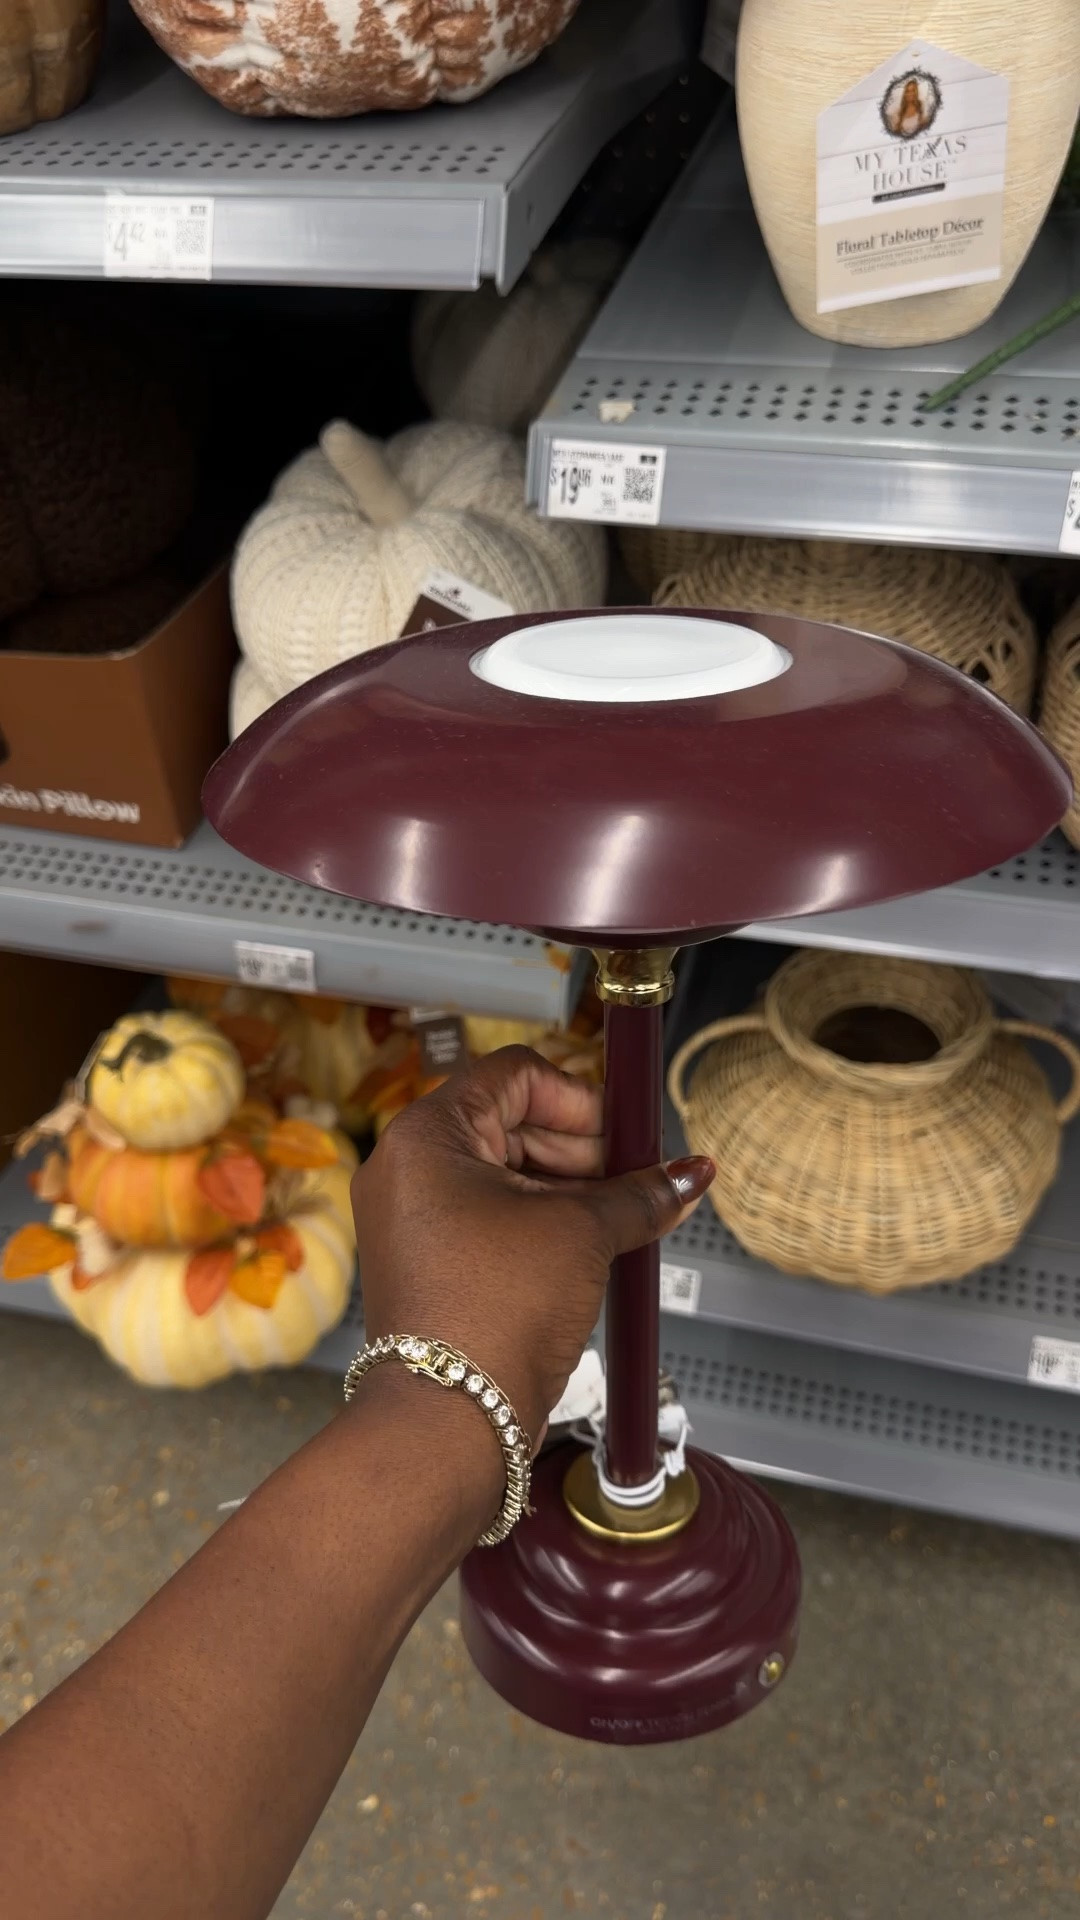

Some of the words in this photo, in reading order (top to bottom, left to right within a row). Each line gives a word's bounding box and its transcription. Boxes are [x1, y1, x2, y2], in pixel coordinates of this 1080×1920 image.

[855, 152, 883, 173] MY
[894, 134, 969, 166] TEXAS
[872, 160, 948, 191] HOUSE
[836, 236, 875, 256] Floral
[880, 227, 939, 247] Tabletop
[942, 217, 984, 236] Décor
[39, 787, 141, 824] Pillow
